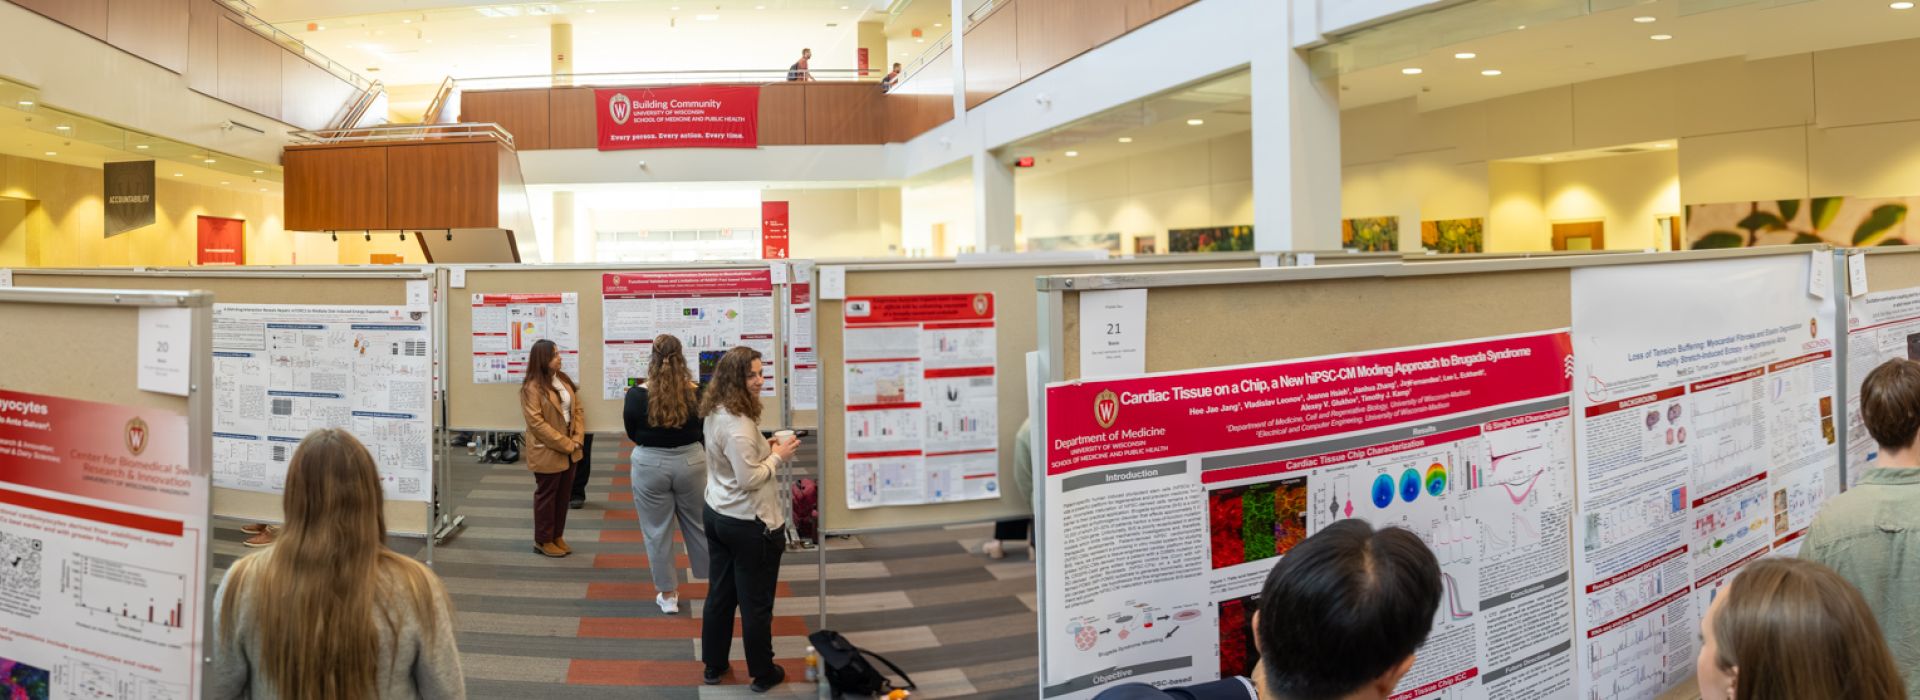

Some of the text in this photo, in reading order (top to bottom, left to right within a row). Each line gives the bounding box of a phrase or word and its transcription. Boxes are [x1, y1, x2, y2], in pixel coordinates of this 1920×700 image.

[632, 100, 722, 110] Building Community
[109, 194, 150, 204] ACCOUNTABILITY
[1107, 323, 1121, 334] 21
[1628, 353, 1644, 362] Loss
[1653, 346, 1677, 358] Tension
[1706, 336, 1735, 348] Myocardial
[1656, 358, 1679, 369] Amplify
[1120, 389, 1170, 405] Cardiac
[1172, 386, 1212, 401] Tissue
[1214, 384, 1230, 396] on
[1231, 382, 1238, 394] a
[1240, 378, 1270, 393] Chip,
[1272, 380, 1278, 389] a
[1280, 376, 1304, 388] New
[1305, 366, 1356, 385] hiPSC-CM
[1394, 358, 1440, 374] Approach
[1440, 357, 1449, 368] to
[1450, 352, 1487, 366] Brugada
[1486, 346, 1531, 362] Syndrome
[0, 399, 48, 415] yocytes
[1244, 398, 1276, 409] Vladislav
[1300, 402, 1323, 411] Alexey
[1619, 394, 1658, 408] BACKGROUND
[1288, 425, 1300, 433] and
[1301, 422, 1330, 431] Computer
[1365, 412, 1393, 421] University
[1318, 411, 1330, 419] and
[1054, 426, 1166, 450] Department of Medicine
[1413, 425, 1436, 436] Results
[1070, 445, 1101, 456] UNIVERSITY
[1112, 440, 1146, 449] WISCONSIN
[1286, 438, 1424, 470] Cardiac Tissue Chip Characterization
[70, 449, 172, 472] Center for Biomedical
[1051, 459, 1072, 468] SCHOOL
[1080, 452, 1109, 462] MEDICINE
[82, 475, 114, 484] UNIVERSITY
[84, 462, 191, 488] Research & Innovation
[1105, 469, 1158, 482] Introduction
[1092, 669, 1134, 686] Objective
[1414, 684, 1437, 696] Tissue
[1438, 679, 1454, 689] Chip
